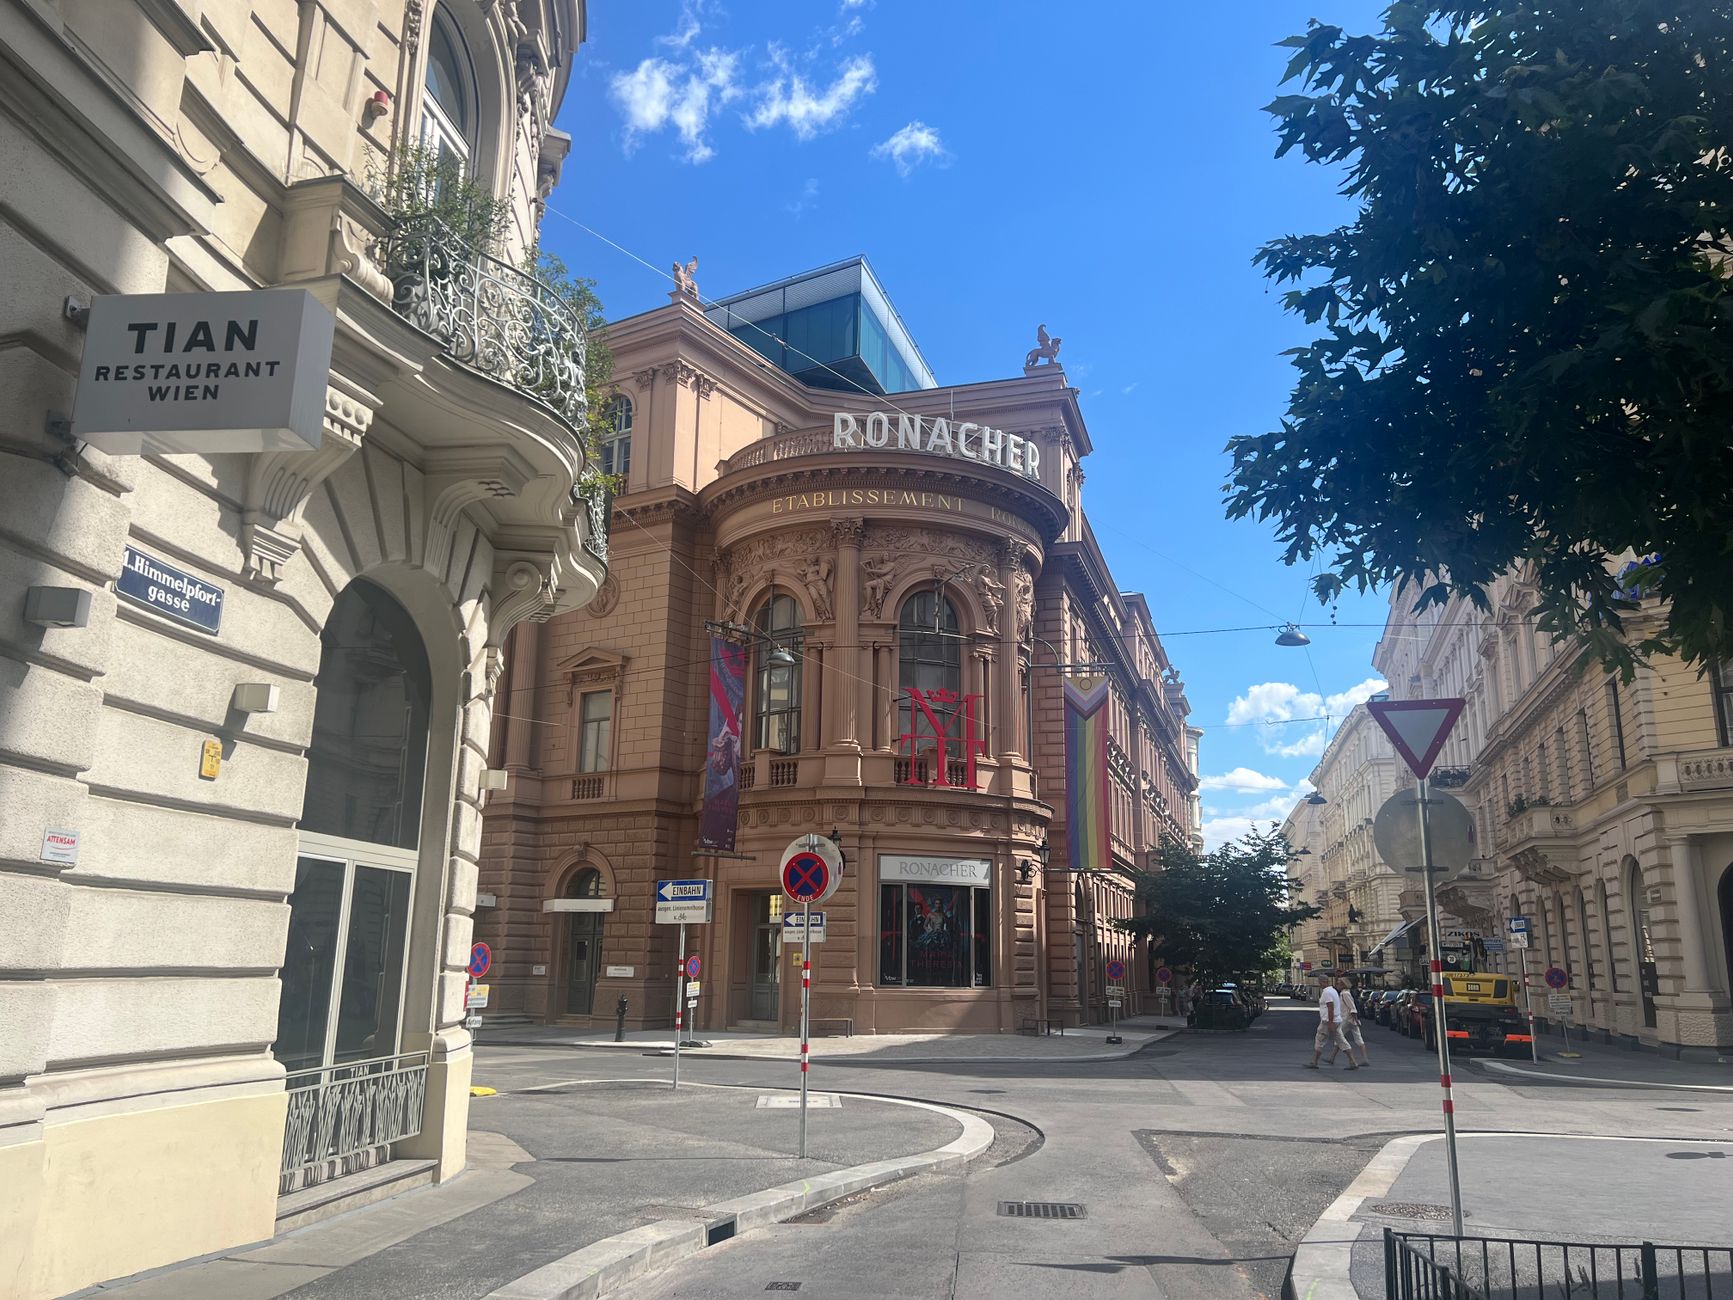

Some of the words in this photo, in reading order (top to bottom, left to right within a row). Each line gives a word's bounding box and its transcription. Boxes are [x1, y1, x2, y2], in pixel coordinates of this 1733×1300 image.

[127, 320, 258, 353] TIAN
[95, 361, 280, 381] RESTAURANT
[148, 384, 219, 401] WIEN
[833, 411, 1040, 480] RONACHER
[772, 489, 966, 514] ETABLISSEMENT
[147, 585, 190, 612] gasse
[47, 836, 76, 845] ATTENSAM
[899, 861, 978, 878] RONACHER
[672, 885, 702, 896] EINBAHN
[797, 894, 814, 902] ENDE
[350, 1065, 370, 1078] TIAN
